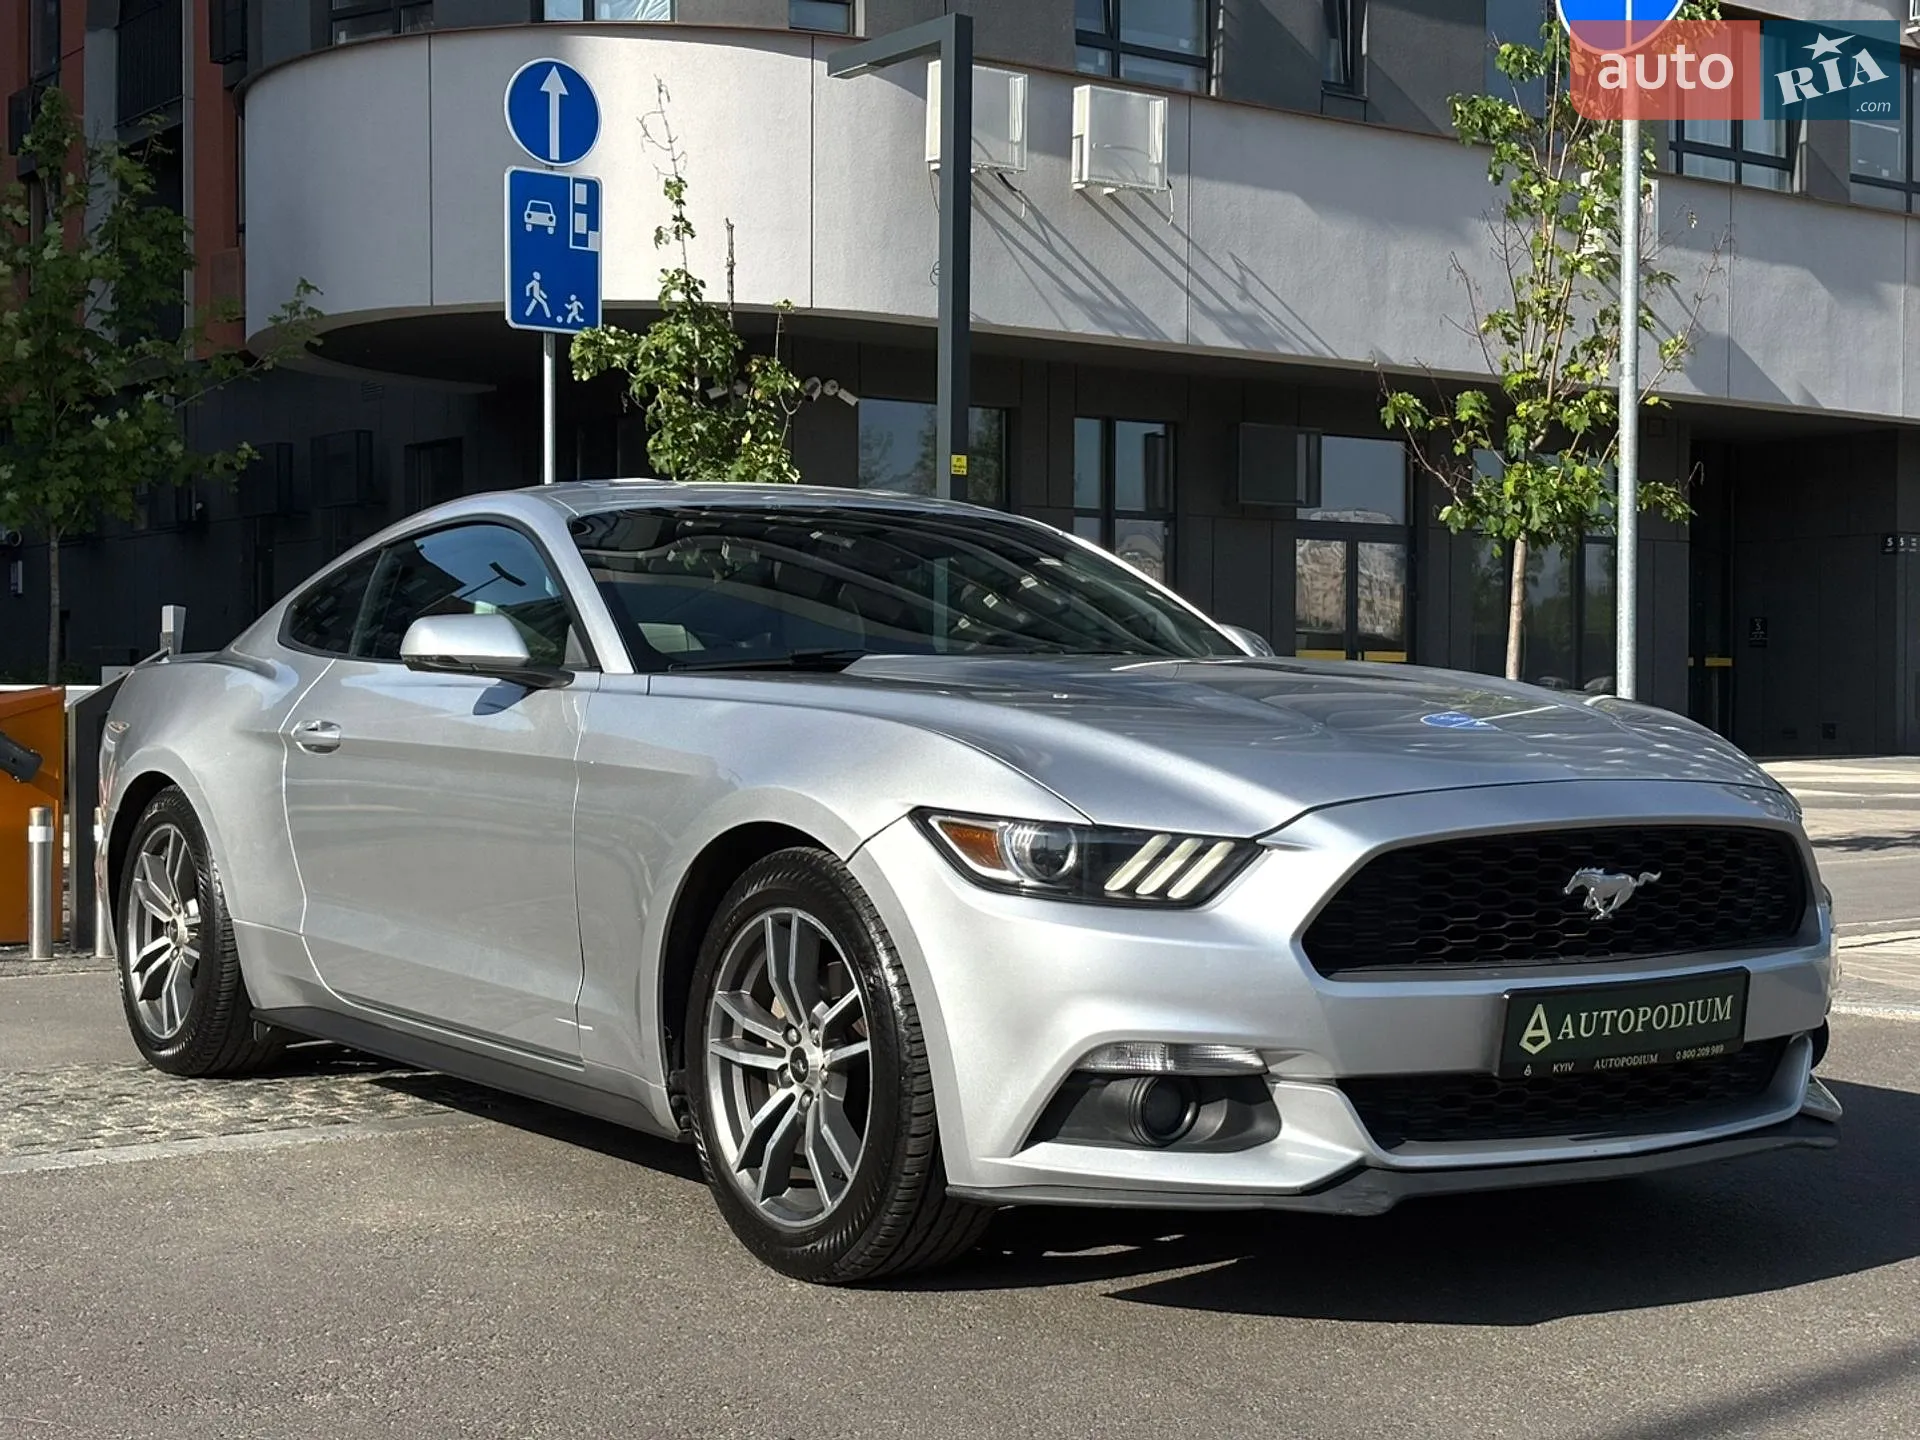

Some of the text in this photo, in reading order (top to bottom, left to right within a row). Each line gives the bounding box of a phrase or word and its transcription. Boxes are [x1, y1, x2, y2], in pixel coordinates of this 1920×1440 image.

[1557, 995, 1734, 1040] AUTOPODIUM
[1552, 1062, 1575, 1073] KYIV
[1593, 1053, 1659, 1071] AUTOPODIUM
